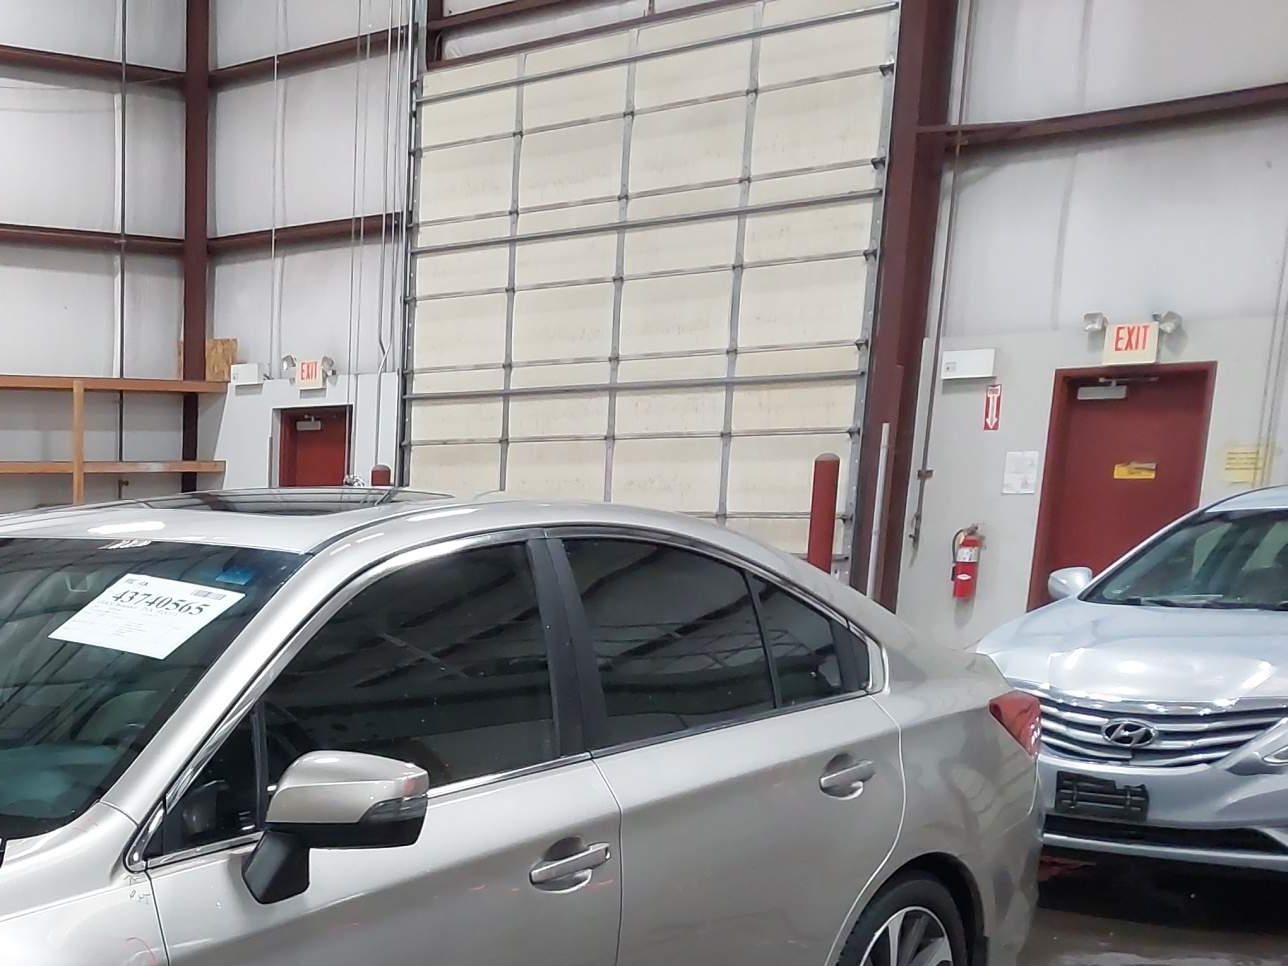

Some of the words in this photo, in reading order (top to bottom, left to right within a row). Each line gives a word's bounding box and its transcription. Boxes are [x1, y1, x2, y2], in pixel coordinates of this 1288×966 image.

[1115, 324, 1150, 351] EXIT
[301, 361, 318, 380] EXIT
[112, 589, 210, 615] 43740565
